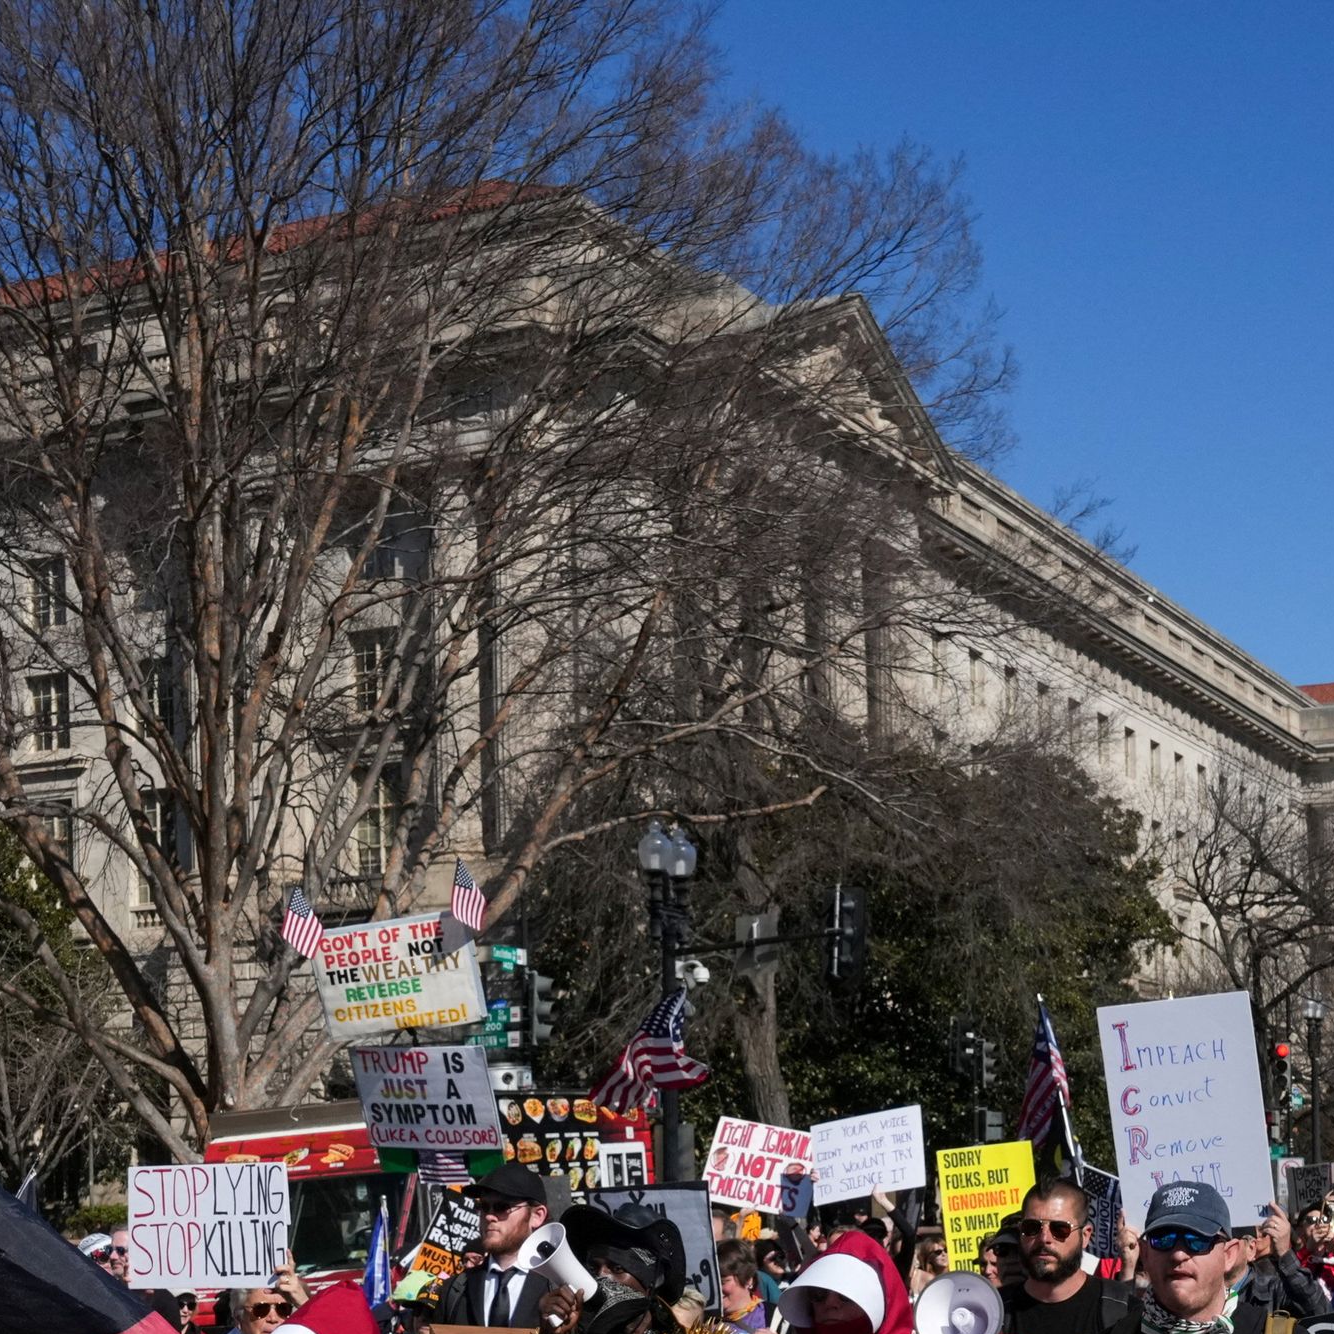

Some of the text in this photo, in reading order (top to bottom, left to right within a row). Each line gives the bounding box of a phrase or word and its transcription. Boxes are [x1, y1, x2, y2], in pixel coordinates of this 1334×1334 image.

[319, 921, 444, 953] GOV'T OF THE
[407, 938, 444, 957] NOT
[326, 951, 460, 986] THE WEALTHY
[345, 979, 423, 1003] REVERSE
[334, 999, 418, 1023] CITIZENS
[394, 1003, 468, 1029] UNITED!
[485, 1022, 503, 1032] 200
[1112, 1021, 1226, 1072] IMPEACH
[356, 1050, 465, 1075] TRUMP IS
[380, 1079, 461, 1100] JUST A
[371, 1103, 477, 1125] SYMPTOM
[718, 1121, 758, 1149] FIGHT
[817, 1115, 909, 1143] IF YOUR VOICE
[851, 1138, 885, 1154] MATTER
[892, 1131, 913, 1145] THEN
[892, 1146, 913, 1162] TRY
[1124, 1125, 1226, 1166] Remove
[735, 1152, 783, 1180] NOT
[943, 1150, 982, 1169] SORRY
[133, 1164, 285, 1218] STOP LYING
[817, 1168, 906, 1198] TO SILENCE IT
[946, 1168, 1009, 1190] FOLKS, BUT
[463, 1197, 475, 1209] Th
[707, 1171, 799, 1212] IMMIGRANTS
[948, 1188, 1020, 1212] IGNORING IT
[448, 1201, 481, 1226] Trum
[950, 1213, 1000, 1232] IS WHAT
[131, 1219, 285, 1278] STOP KILLING
[953, 1236, 973, 1254] THE
